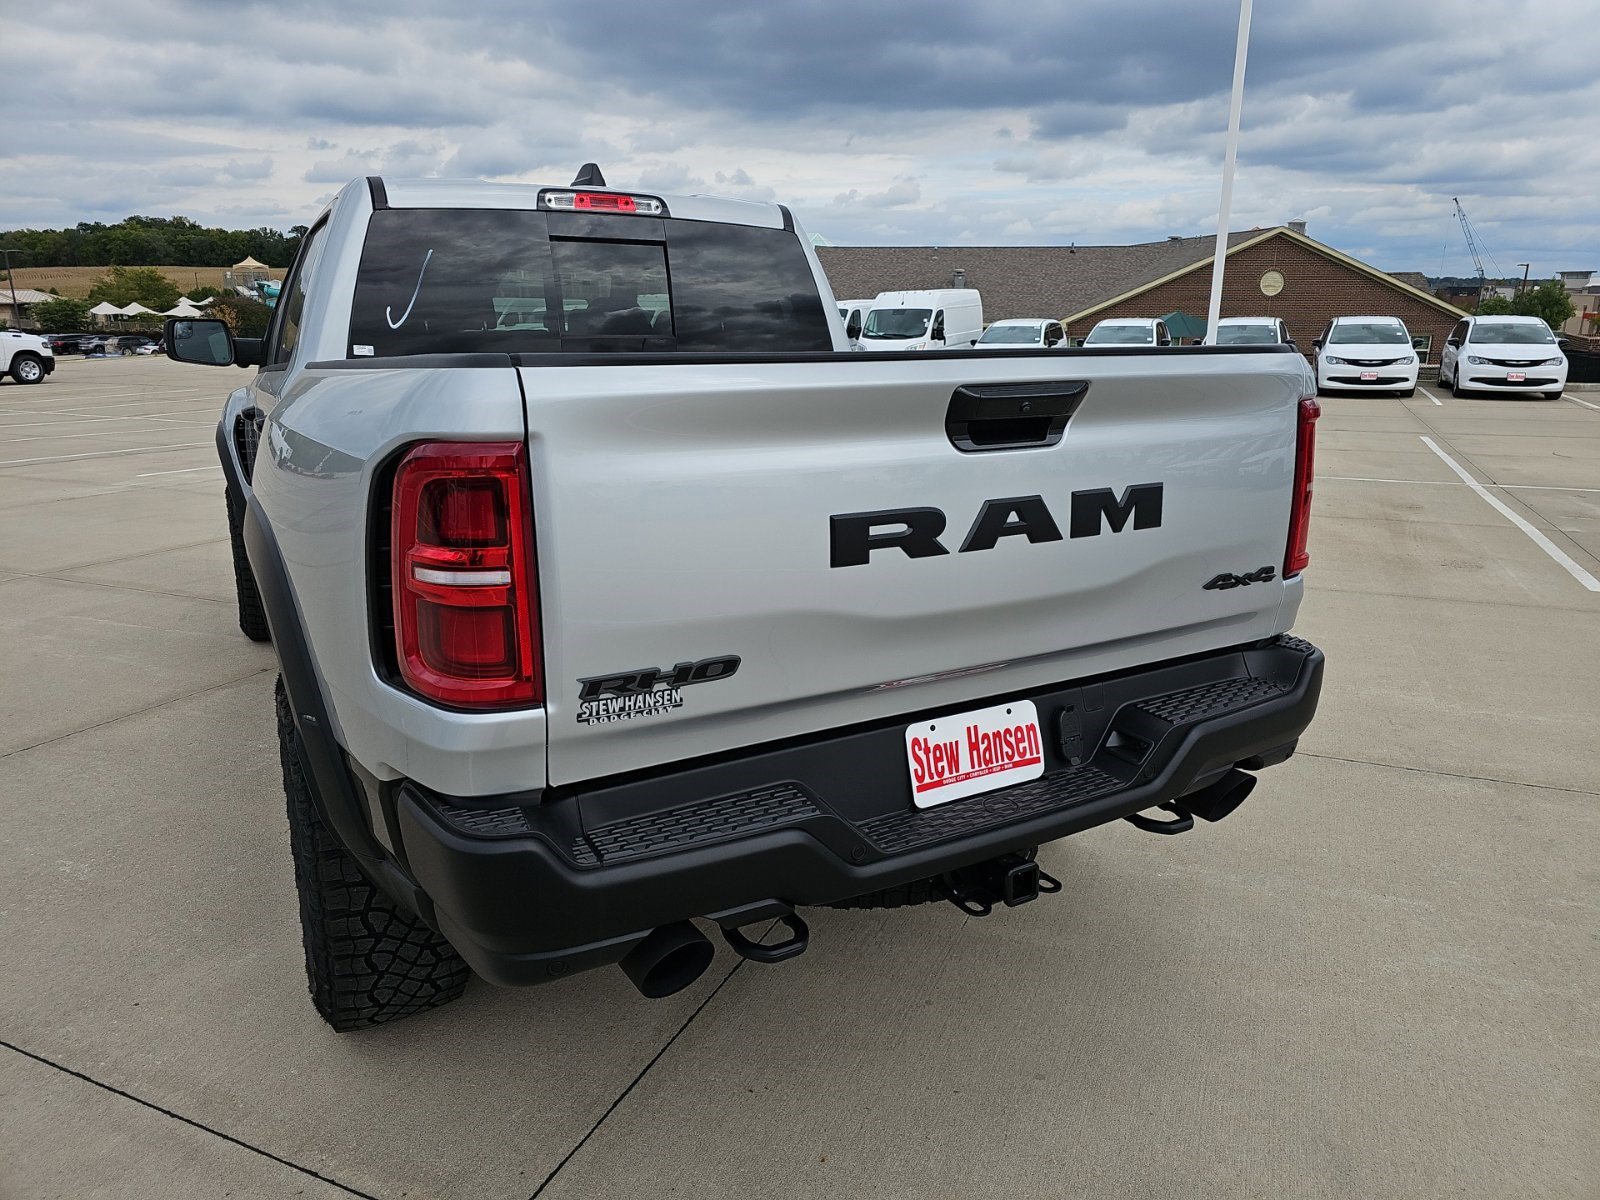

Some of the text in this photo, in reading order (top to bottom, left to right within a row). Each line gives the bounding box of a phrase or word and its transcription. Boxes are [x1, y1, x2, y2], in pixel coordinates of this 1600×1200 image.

[830, 482, 1164, 568] RAM
[1202, 565, 1277, 590] 4x4
[576, 654, 741, 700] RHO
[581, 689, 681, 718] STEW HANSEN
[589, 705, 673, 726] DODGE CITY
[911, 722, 1040, 783] Stew Hansen
